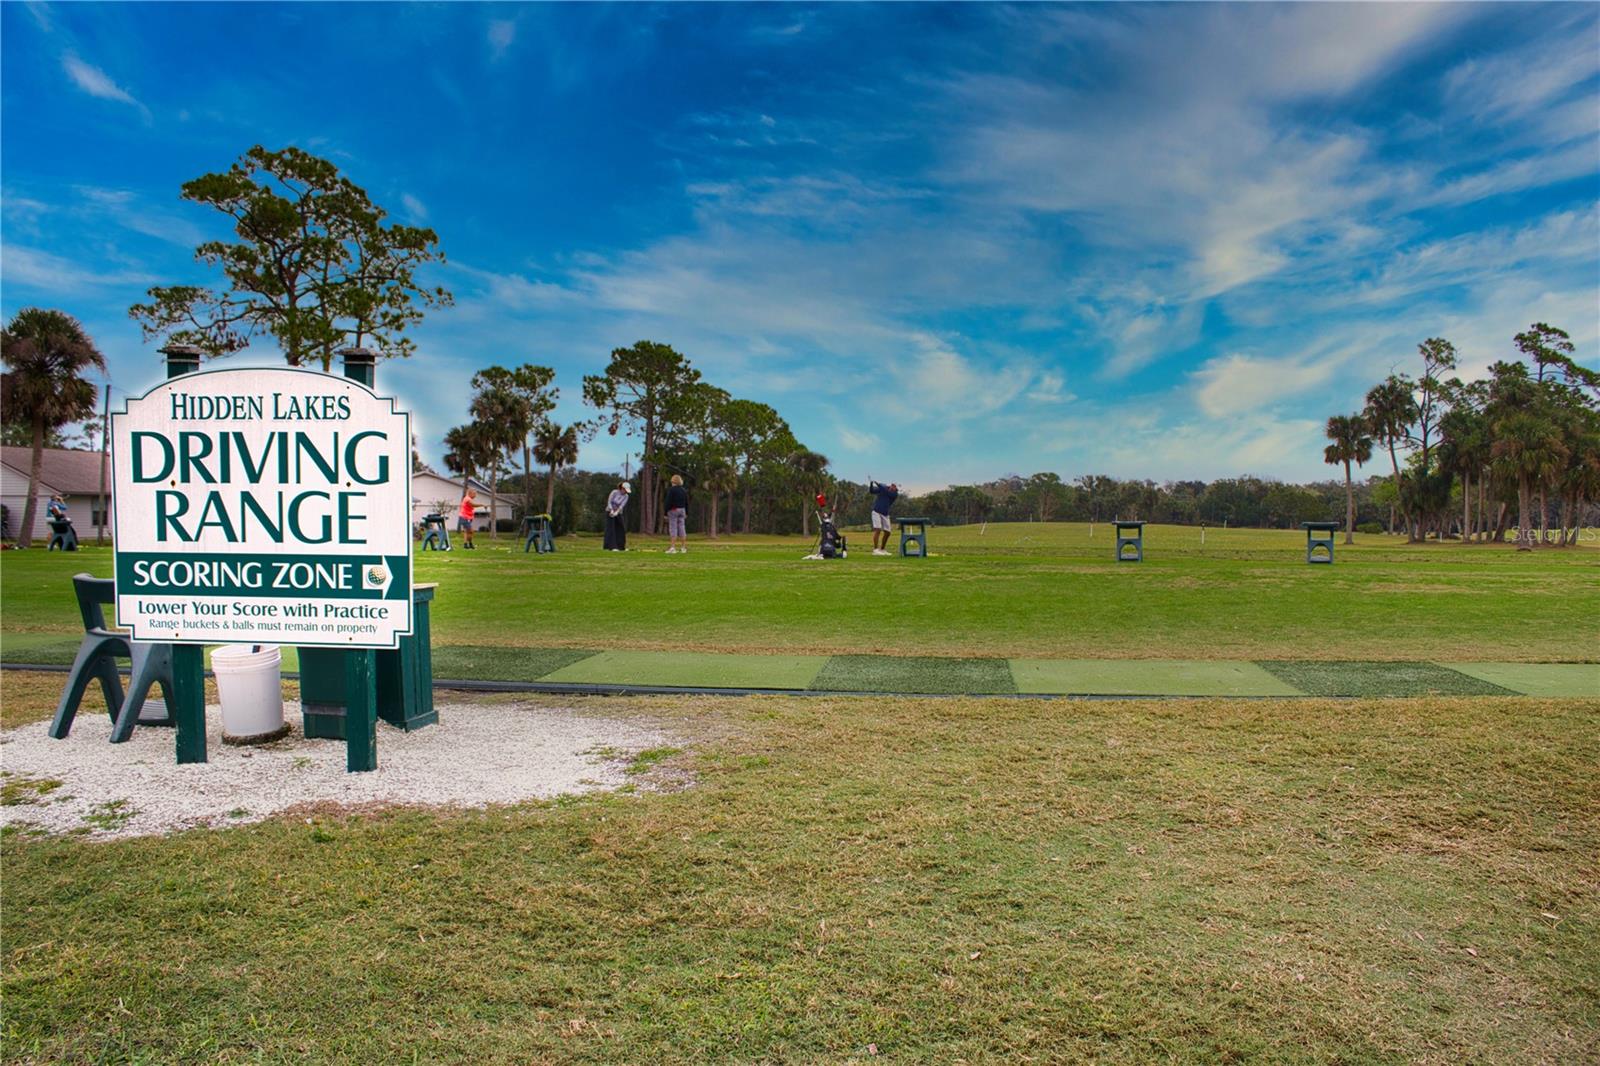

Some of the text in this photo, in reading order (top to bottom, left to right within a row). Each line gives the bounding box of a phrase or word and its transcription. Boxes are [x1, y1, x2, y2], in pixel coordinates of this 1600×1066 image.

[171, 393, 351, 421] HIDDEN LAKES
[130, 431, 390, 485] DRIVING
[155, 490, 368, 545] RANGE
[133, 560, 353, 590] SCORING ZONE
[138, 600, 389, 620] Lower Your Score with Practice
[149, 618, 378, 635] Range buckets & balls must remain on property
